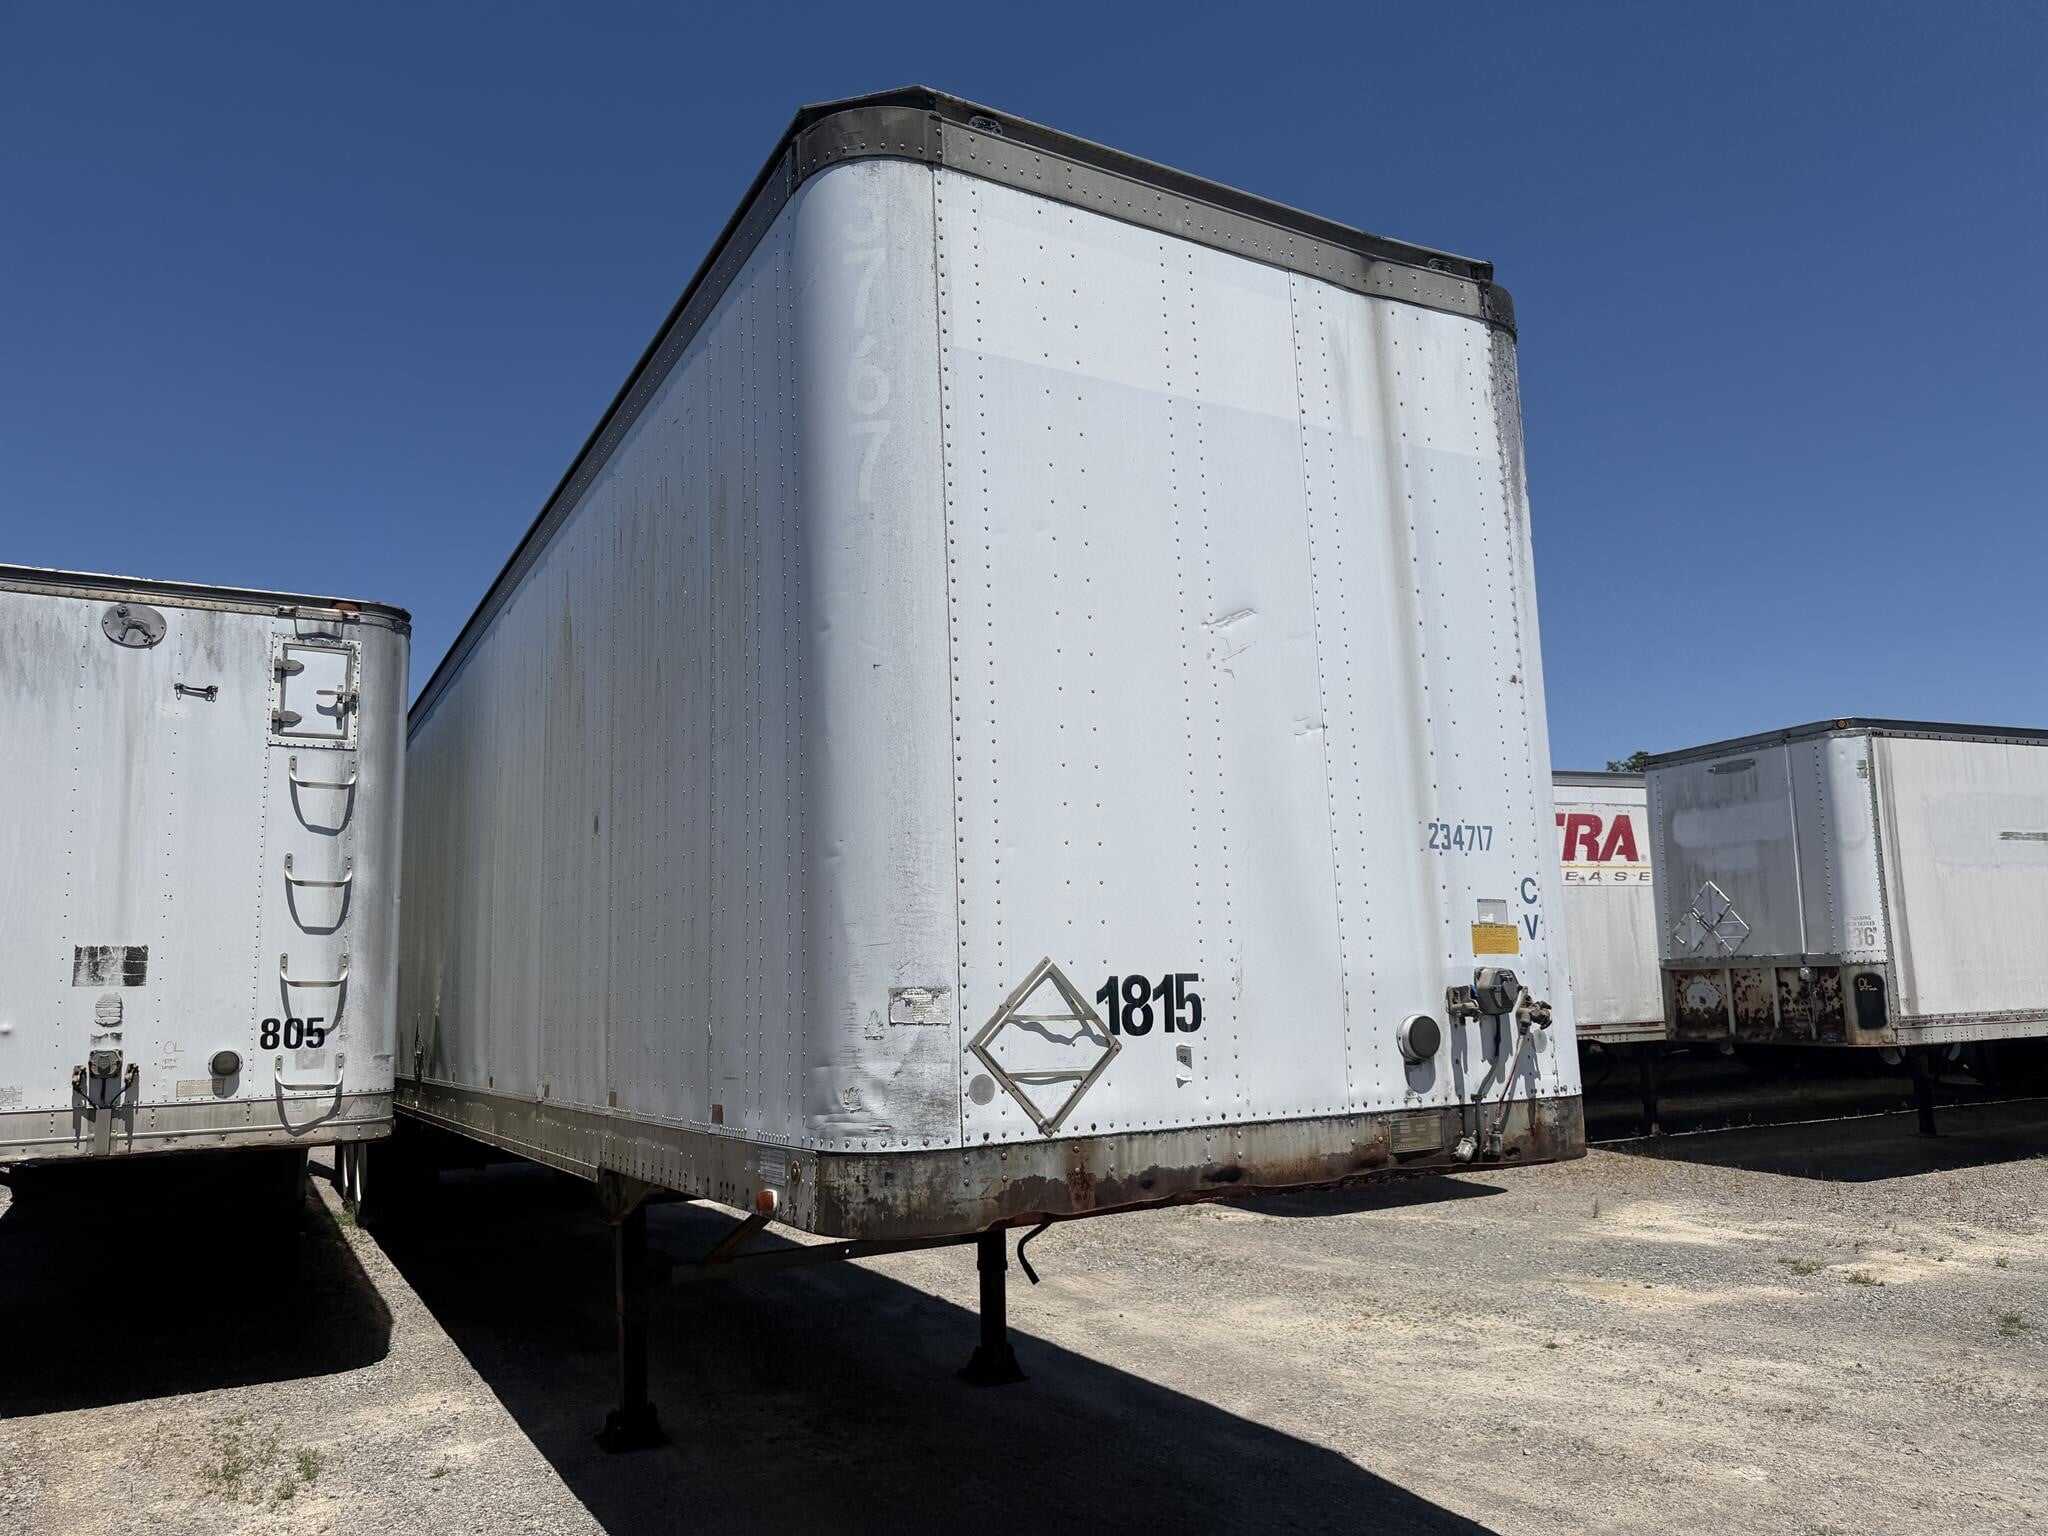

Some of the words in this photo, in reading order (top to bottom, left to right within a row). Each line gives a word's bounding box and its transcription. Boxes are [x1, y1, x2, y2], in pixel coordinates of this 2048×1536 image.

[1428, 822, 1493, 851] 234717
[1565, 871, 1651, 882] EASE
[1096, 973, 1202, 1036] 1815
[260, 1017, 325, 1050] 805
